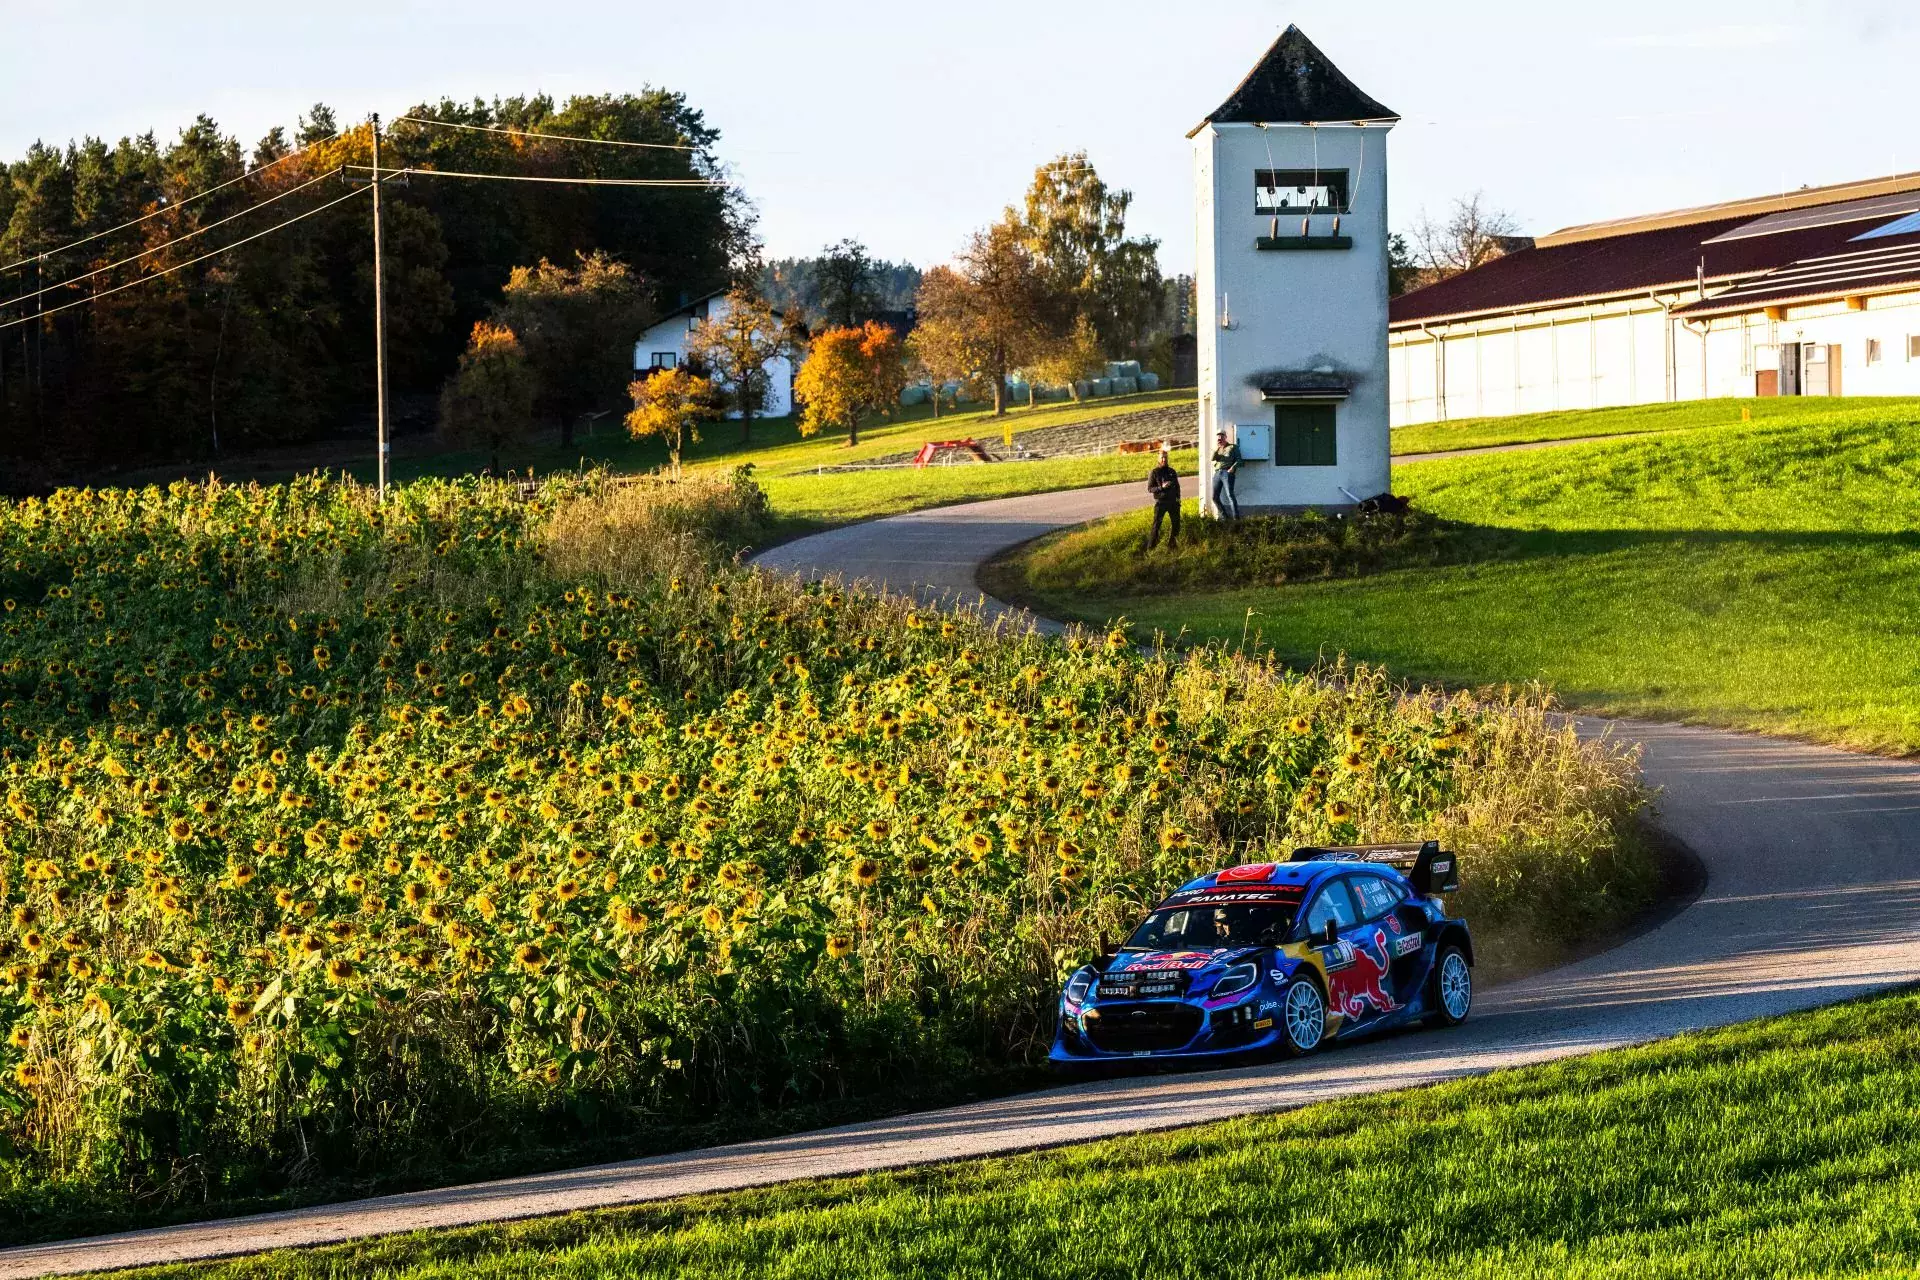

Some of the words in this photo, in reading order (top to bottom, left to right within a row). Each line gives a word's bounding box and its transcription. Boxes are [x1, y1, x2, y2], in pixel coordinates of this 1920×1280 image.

[1170, 888, 1205, 898] FORD
[1205, 885, 1304, 893] PERFORMANCE
[1187, 893, 1273, 902] FANATEC
[1401, 933, 1420, 953] Castrol
[1125, 962, 1164, 971] Red
[1163, 960, 1209, 970] Bull
